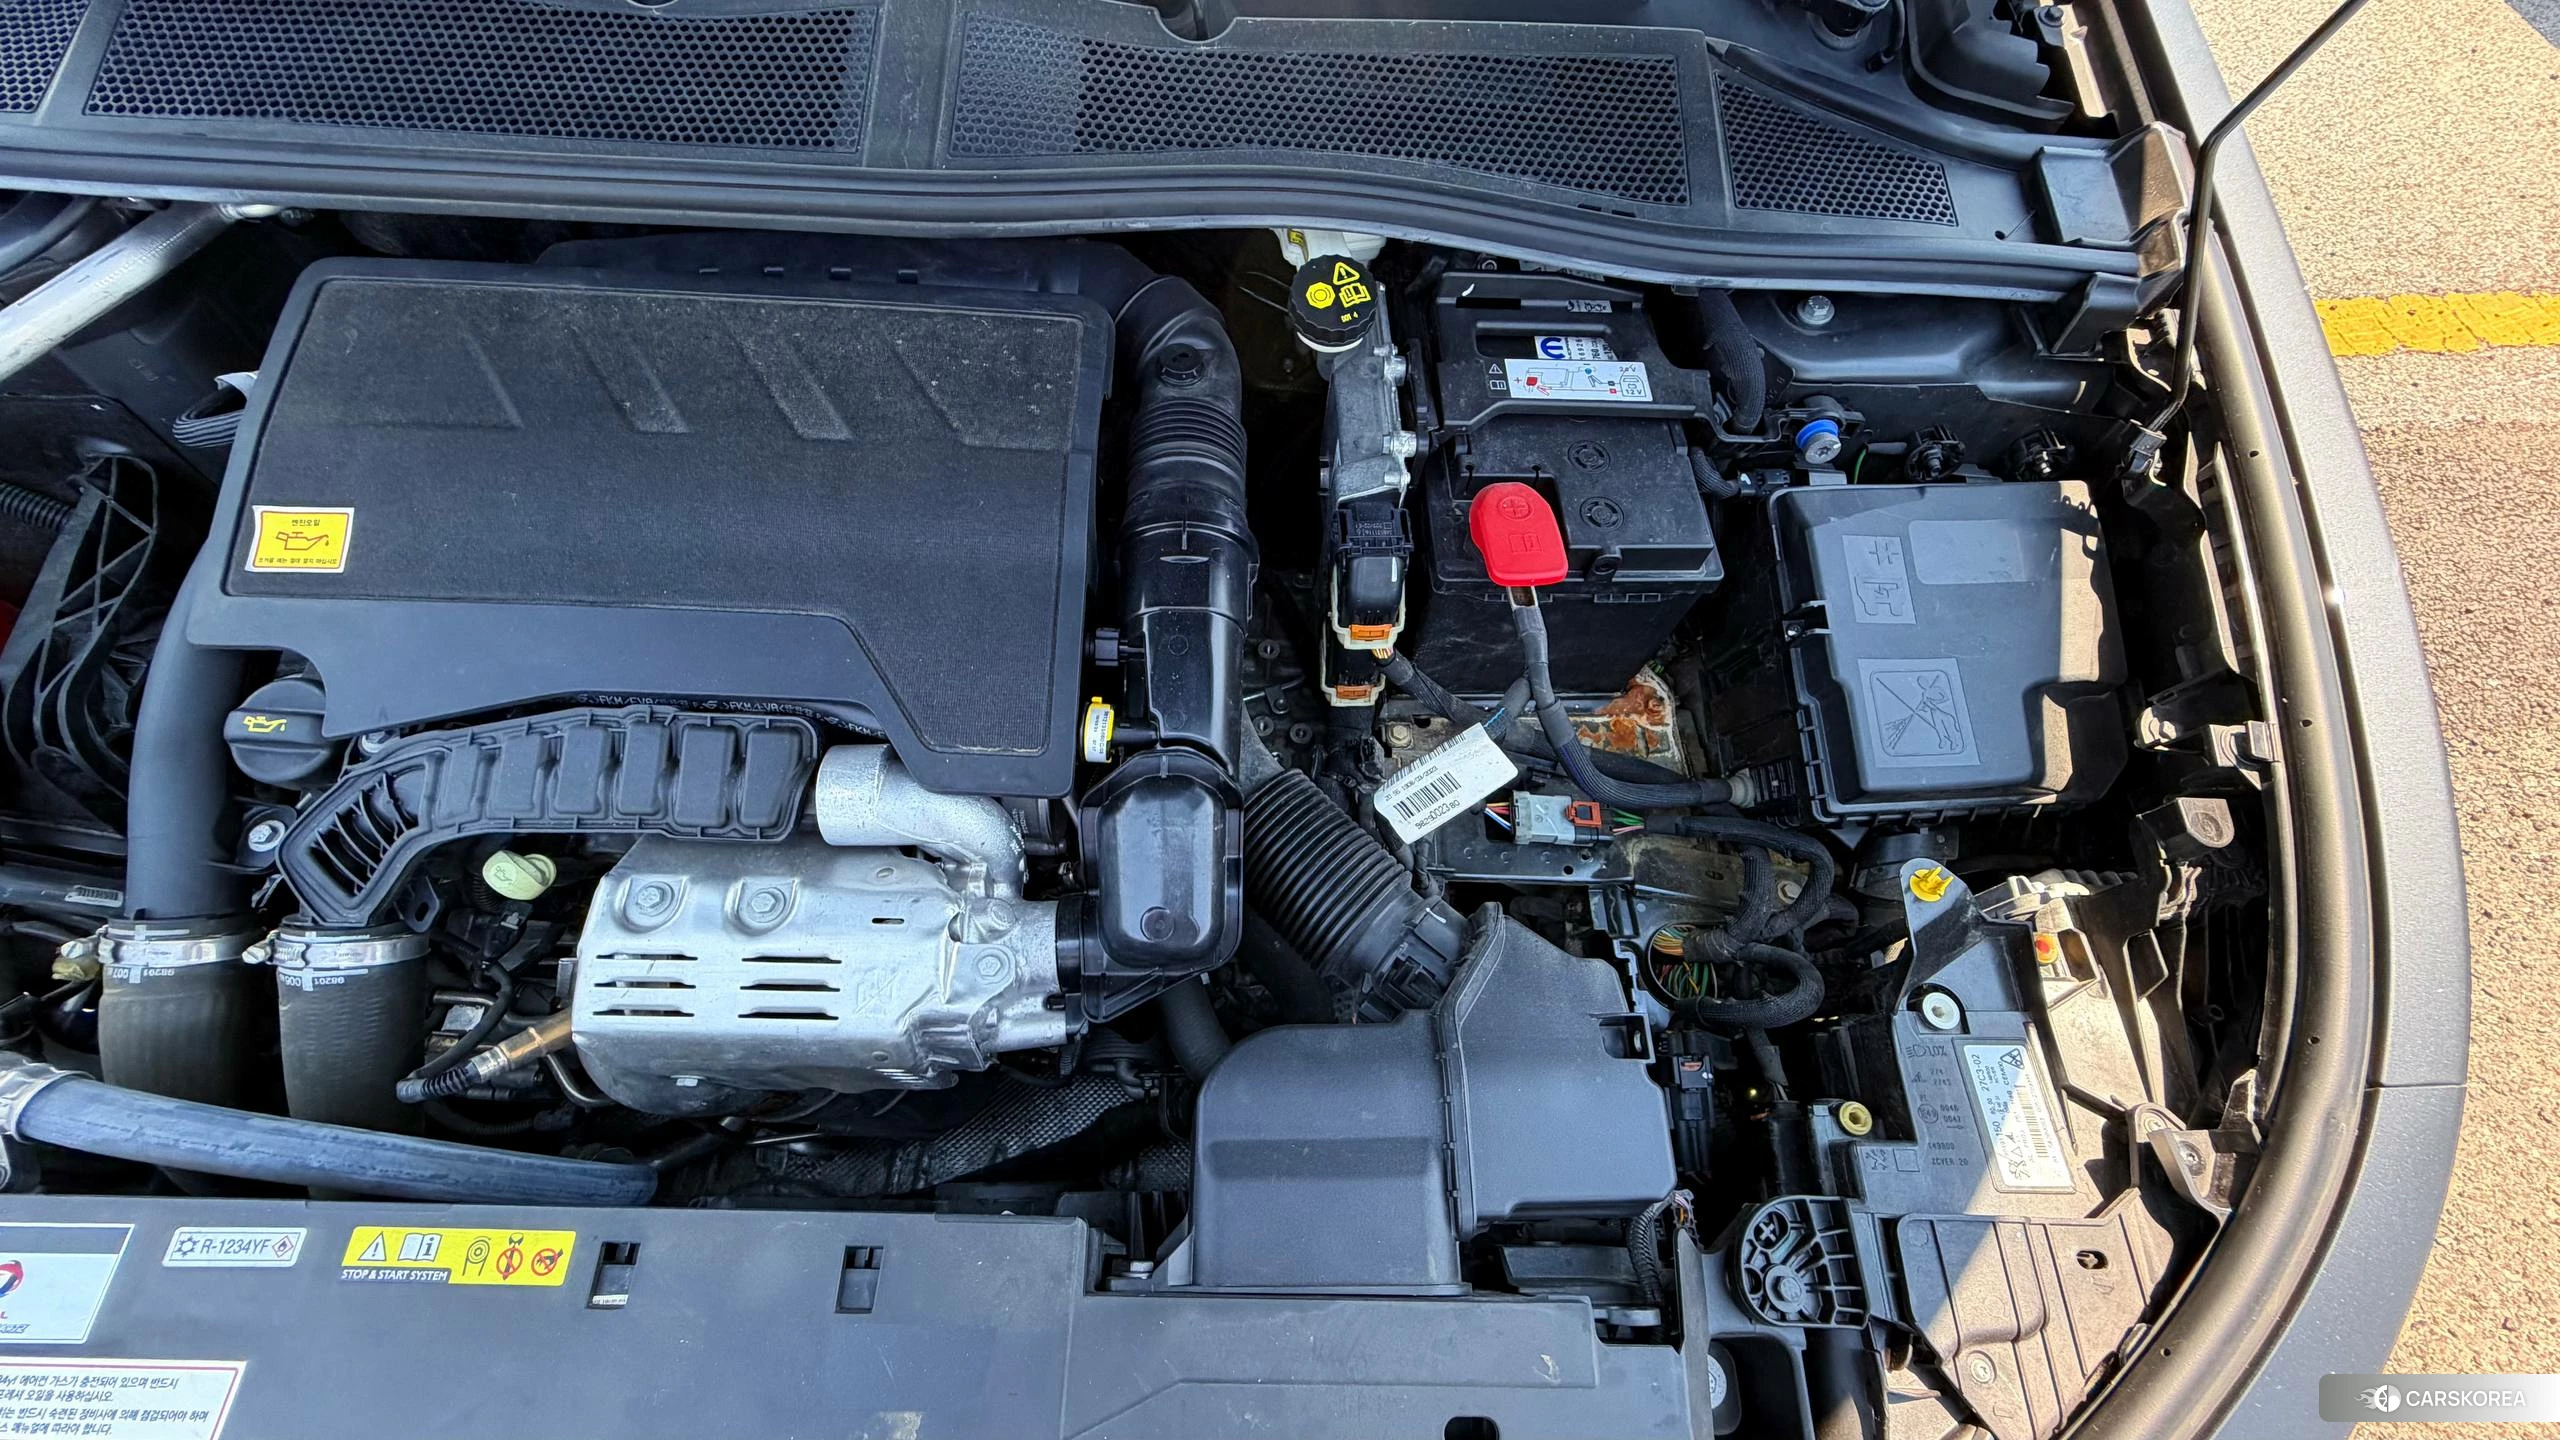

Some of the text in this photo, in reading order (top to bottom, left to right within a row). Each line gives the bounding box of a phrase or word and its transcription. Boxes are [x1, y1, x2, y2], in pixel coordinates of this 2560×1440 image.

[200, 1238, 271, 1255] R-1234YF
[341, 1269, 448, 1281] STOP & START SYSTEM
